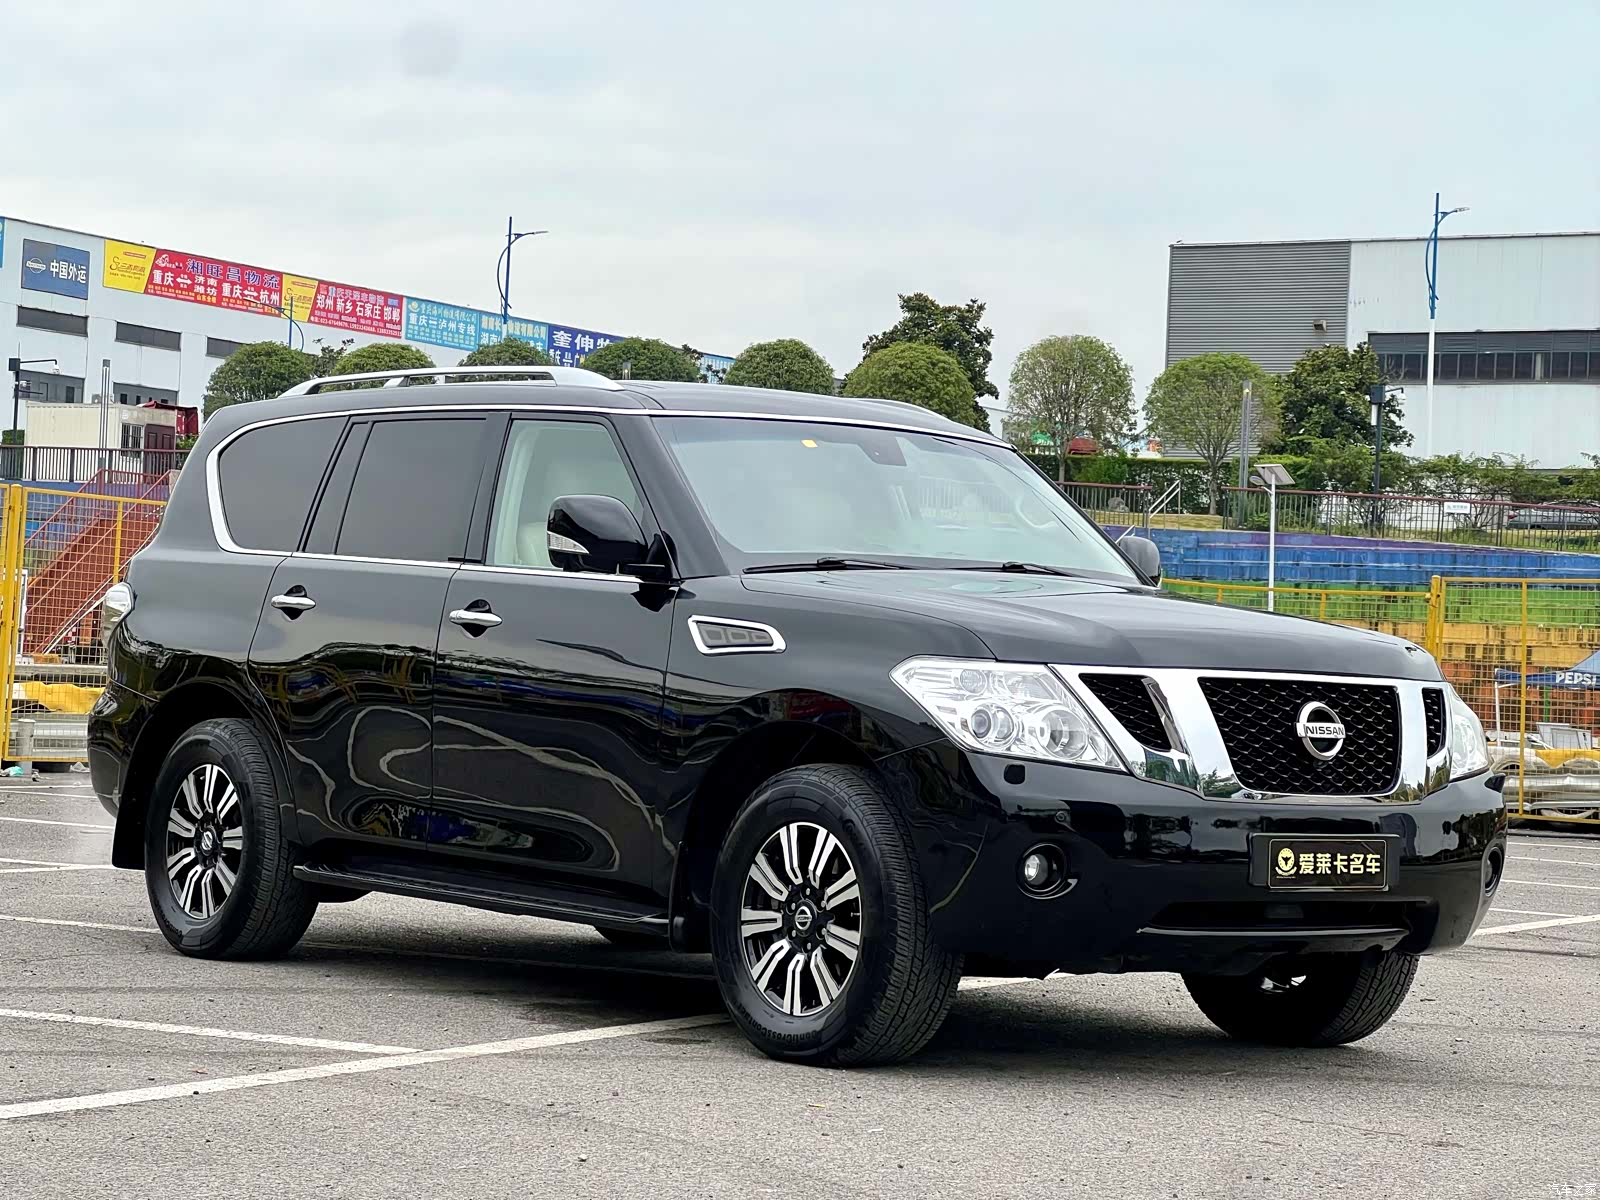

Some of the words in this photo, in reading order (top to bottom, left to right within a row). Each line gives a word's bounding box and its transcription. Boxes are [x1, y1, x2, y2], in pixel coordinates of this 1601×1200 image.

[50, 259, 87, 284] 中国外运
[152, 269, 175, 287] 重庆
[186, 258, 280, 289] 湘旺昌物流
[221, 282, 243, 299] 重庆
[259, 288, 280, 306] 杭州
[316, 294, 334, 311] 郑州
[336, 298, 353, 314] 新乡
[355, 302, 381, 319] 石家庄
[383, 306, 401, 323] 邯郸
[1555, 671, 1597, 686] PEPSI
[1305, 725, 1345, 736] NISSAN
[1299, 853, 1381, 875] 爱莱卡名车
